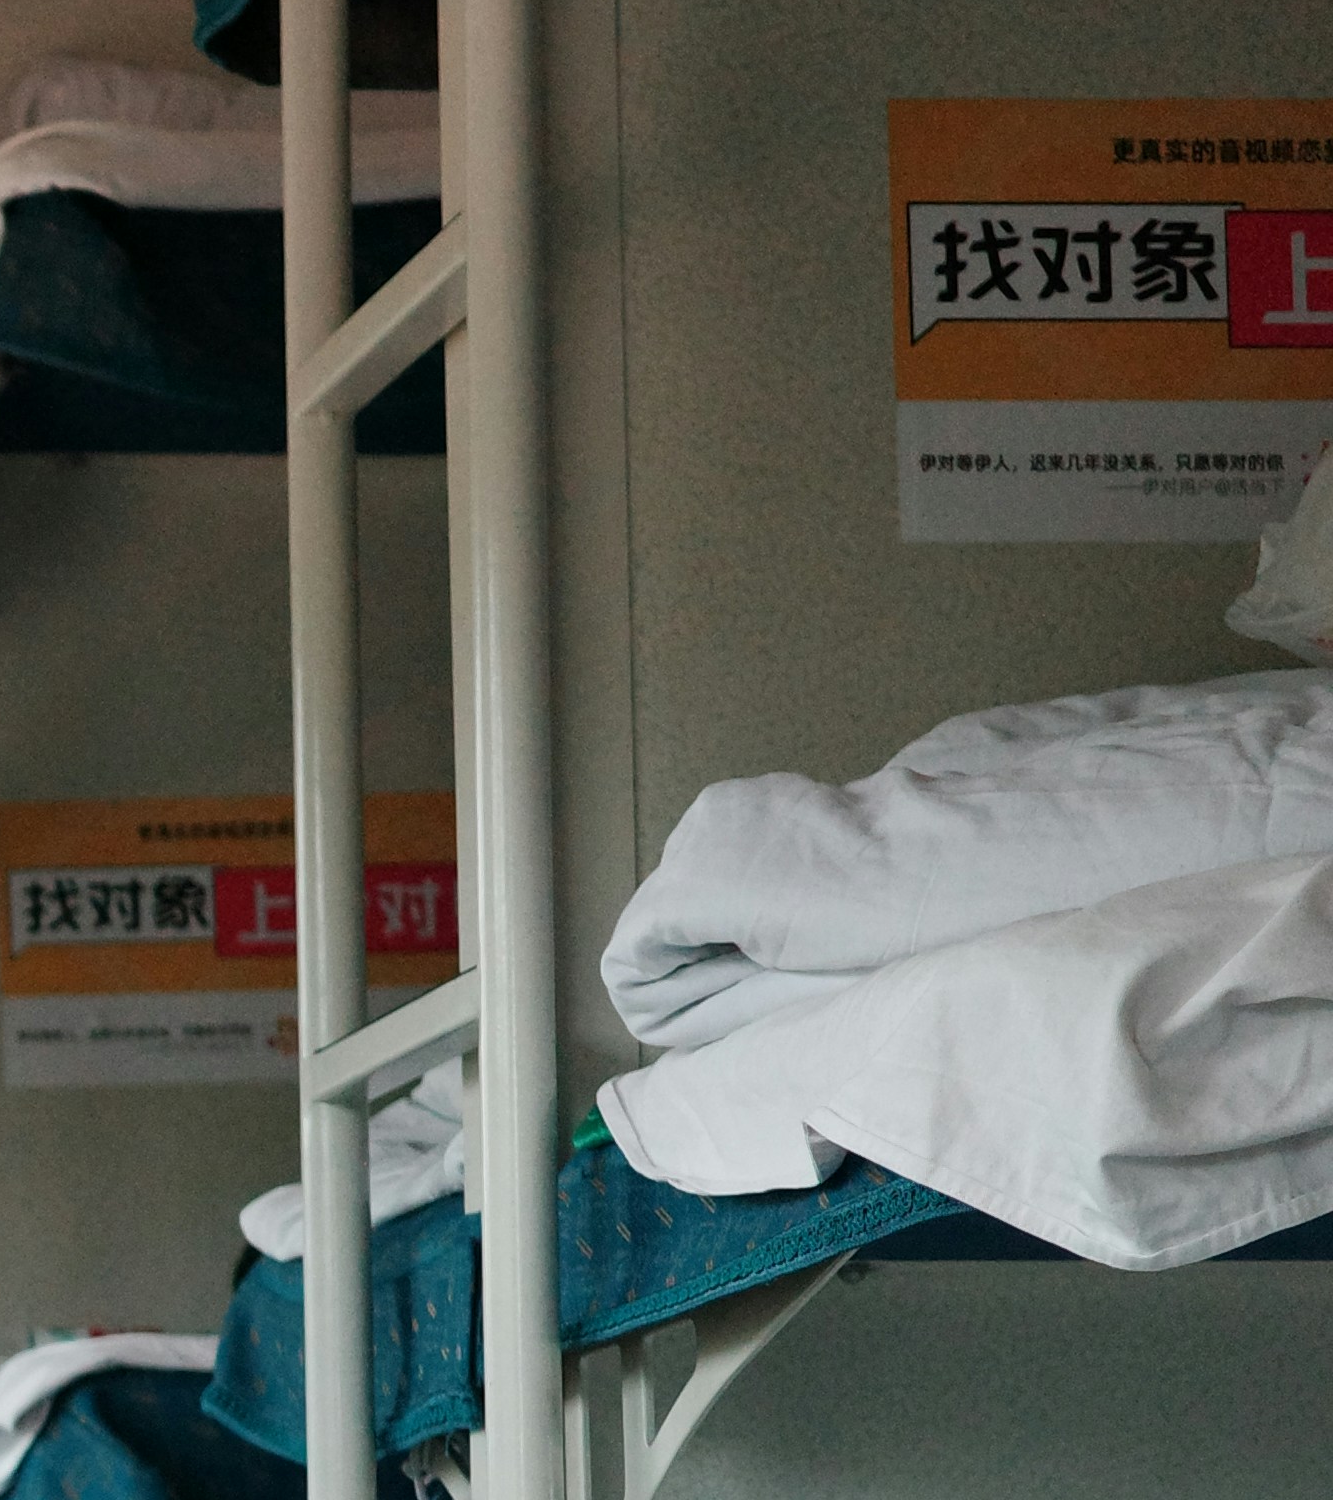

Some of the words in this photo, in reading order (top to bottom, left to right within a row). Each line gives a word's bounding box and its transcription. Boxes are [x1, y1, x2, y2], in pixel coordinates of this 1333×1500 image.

[933, 218, 1219, 303] 找对象
[24, 874, 210, 934] 找对象
